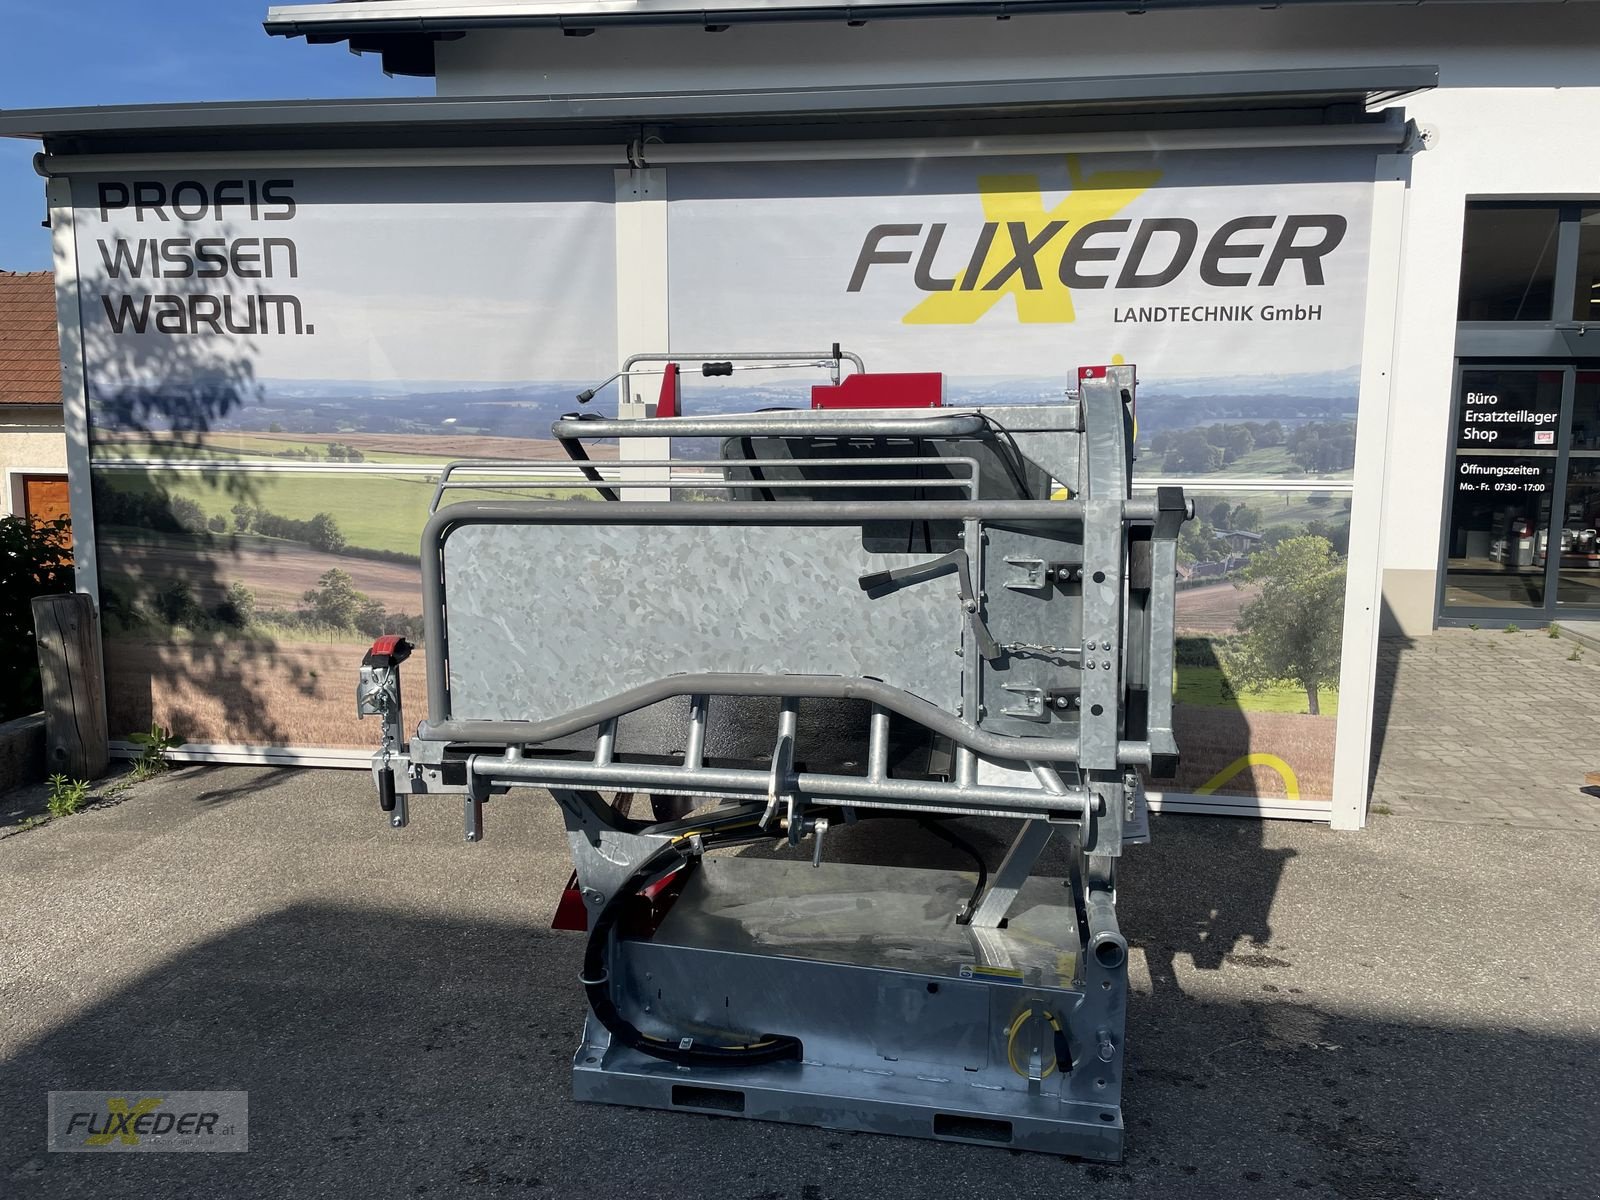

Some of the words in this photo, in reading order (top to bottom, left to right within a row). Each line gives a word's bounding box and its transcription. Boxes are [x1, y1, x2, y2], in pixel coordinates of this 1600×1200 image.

[98, 180, 296, 222] PROFIS
[96, 237, 298, 279] WISSEN
[847, 214, 1348, 292] FLIXEDER
[1114, 305, 1254, 323] LANDTECHNIK
[1260, 304, 1322, 321] GmbH
[1466, 392, 1498, 405] Büro
[1465, 409, 1558, 425] Ersatzteillager
[1463, 427, 1498, 442] Shop
[1460, 463, 1540, 477] Öffnungszeiten
[1494, 483, 1517, 491] 07:30
[1523, 483, 1546, 492] 17:00
